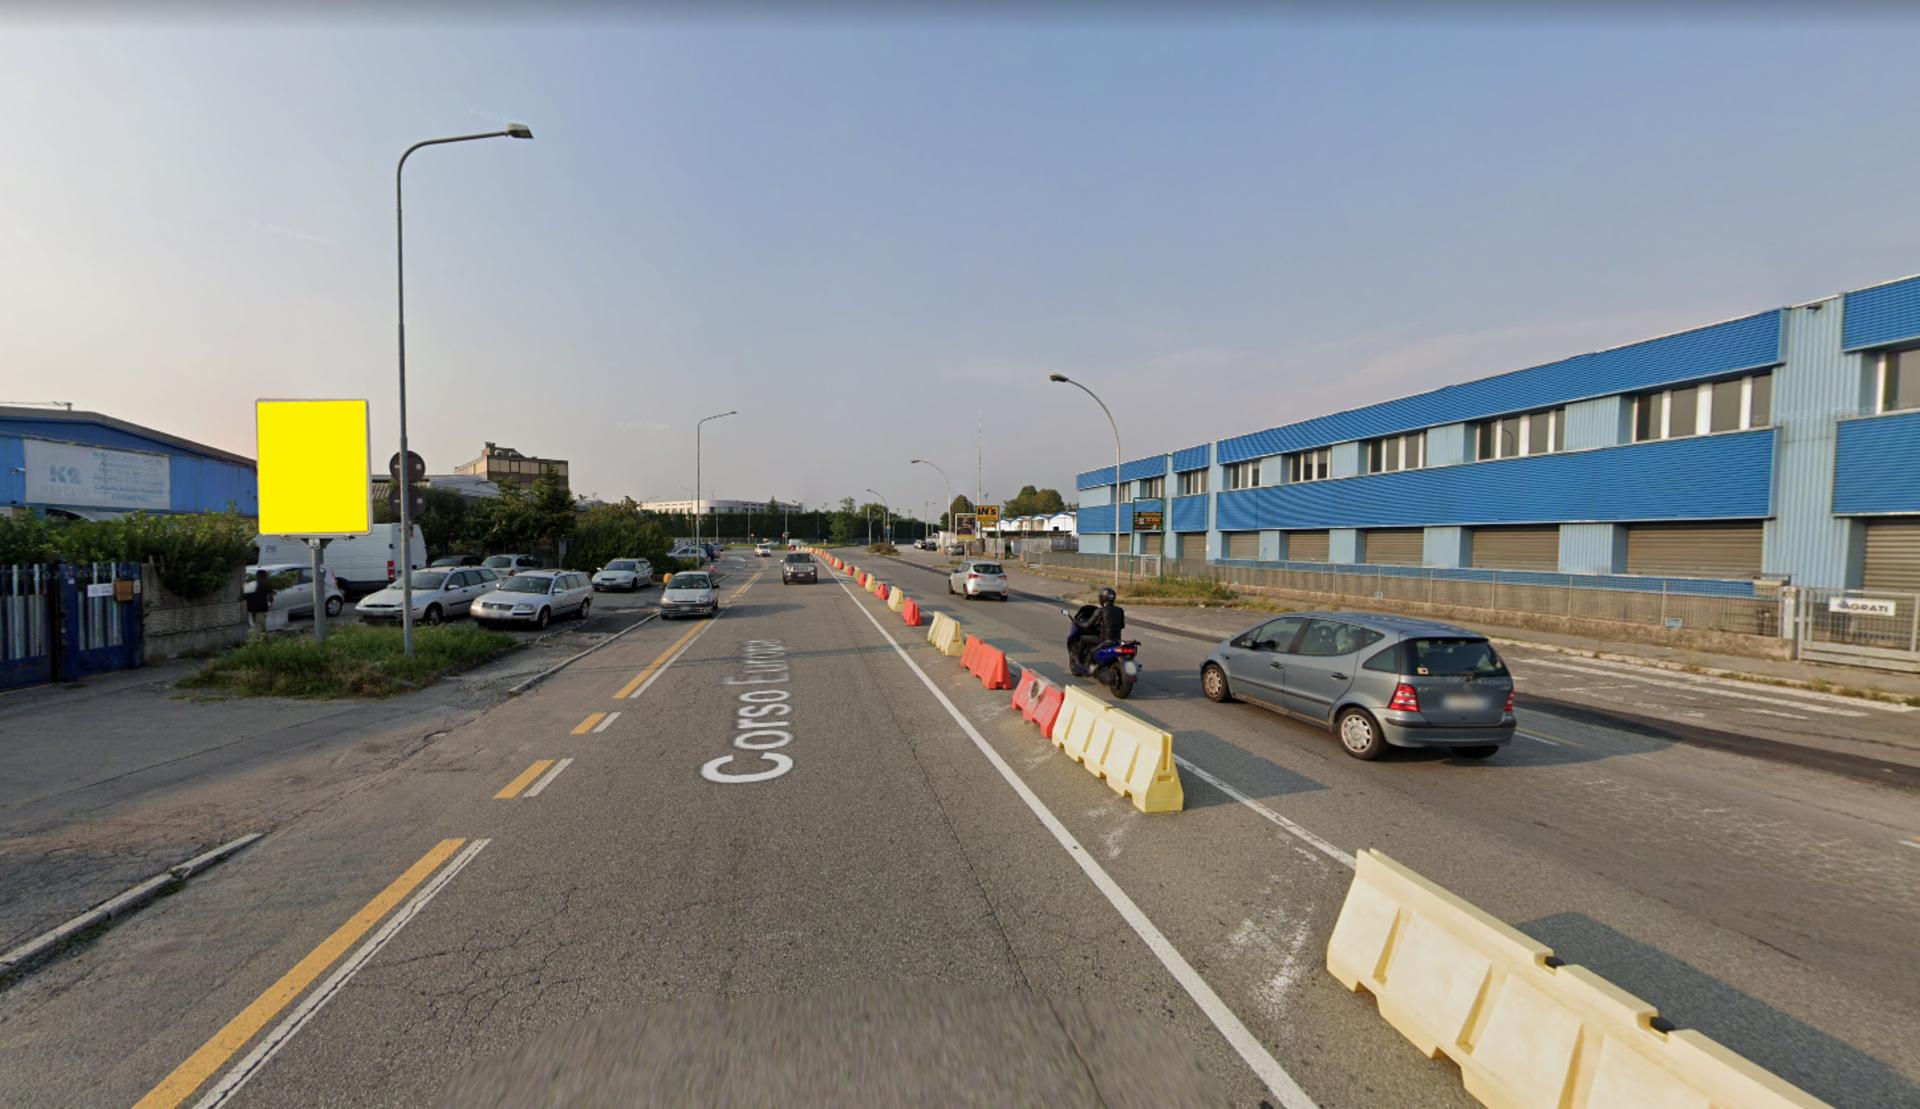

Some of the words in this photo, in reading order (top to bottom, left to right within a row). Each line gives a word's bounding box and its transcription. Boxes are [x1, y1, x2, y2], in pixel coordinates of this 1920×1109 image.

[48, 464, 82, 485] K2
[1838, 599, 1889, 612] AGRATI
[700, 689, 794, 784] Corso
